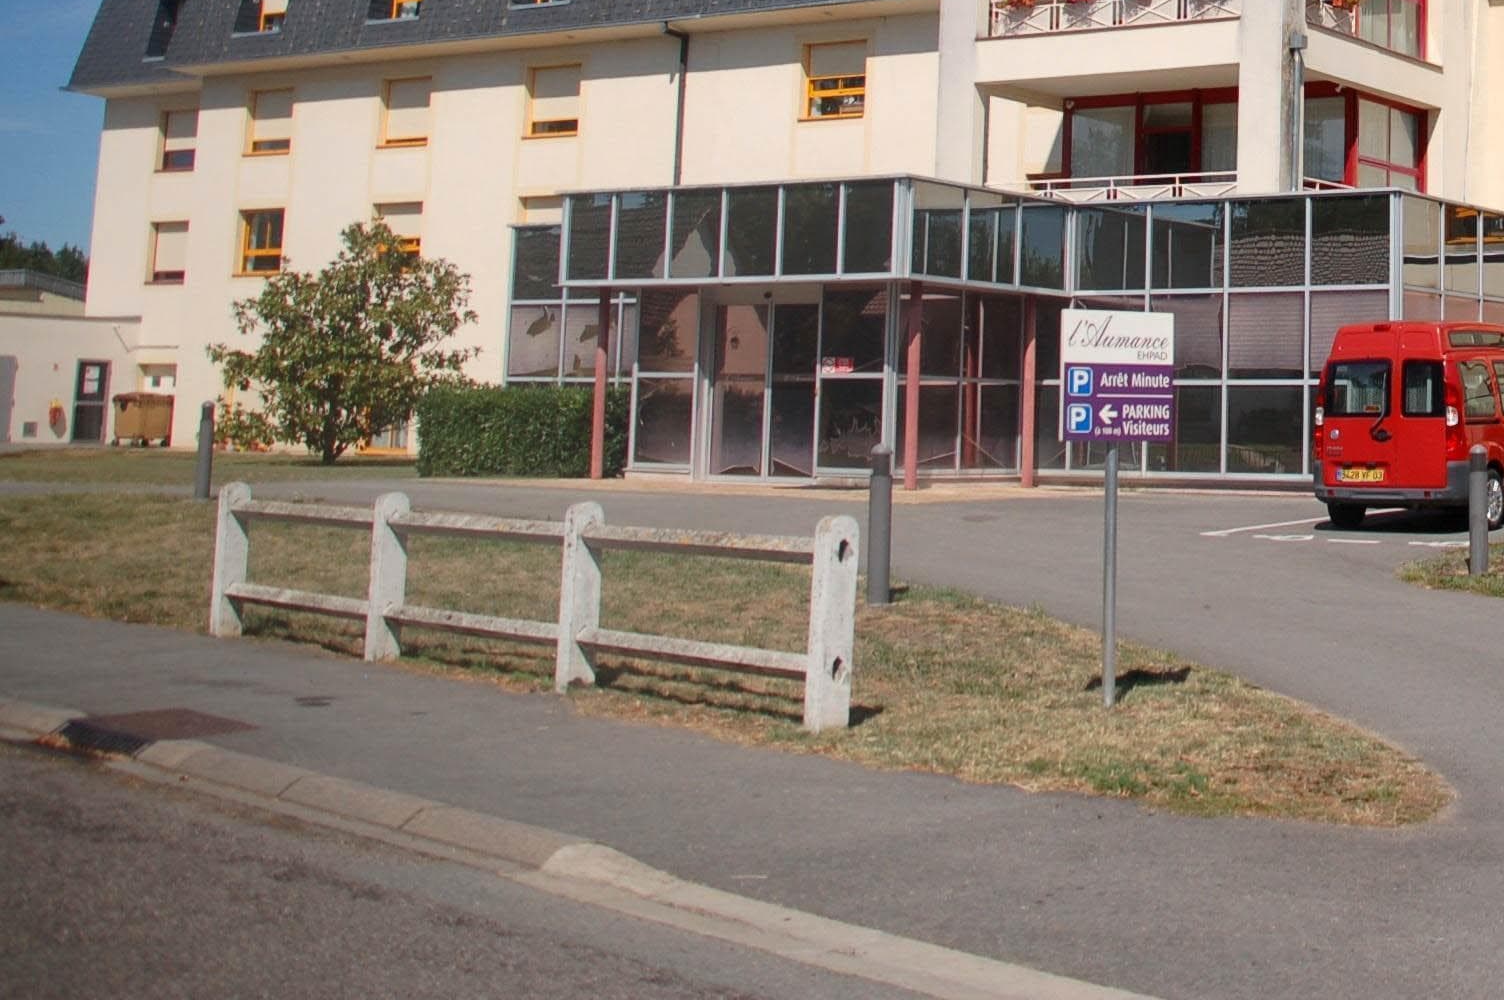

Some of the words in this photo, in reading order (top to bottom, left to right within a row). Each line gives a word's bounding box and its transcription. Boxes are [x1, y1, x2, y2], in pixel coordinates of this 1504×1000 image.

[1068, 315, 1169, 349] l'Aumance
[1072, 370, 1089, 393] P
[1100, 371, 1129, 387] Arrêt
[1131, 371, 1170, 388] Minute
[1070, 407, 1087, 430] P
[1122, 404, 1170, 420] PARKING
[1122, 419, 1170, 436] Visiteurs
